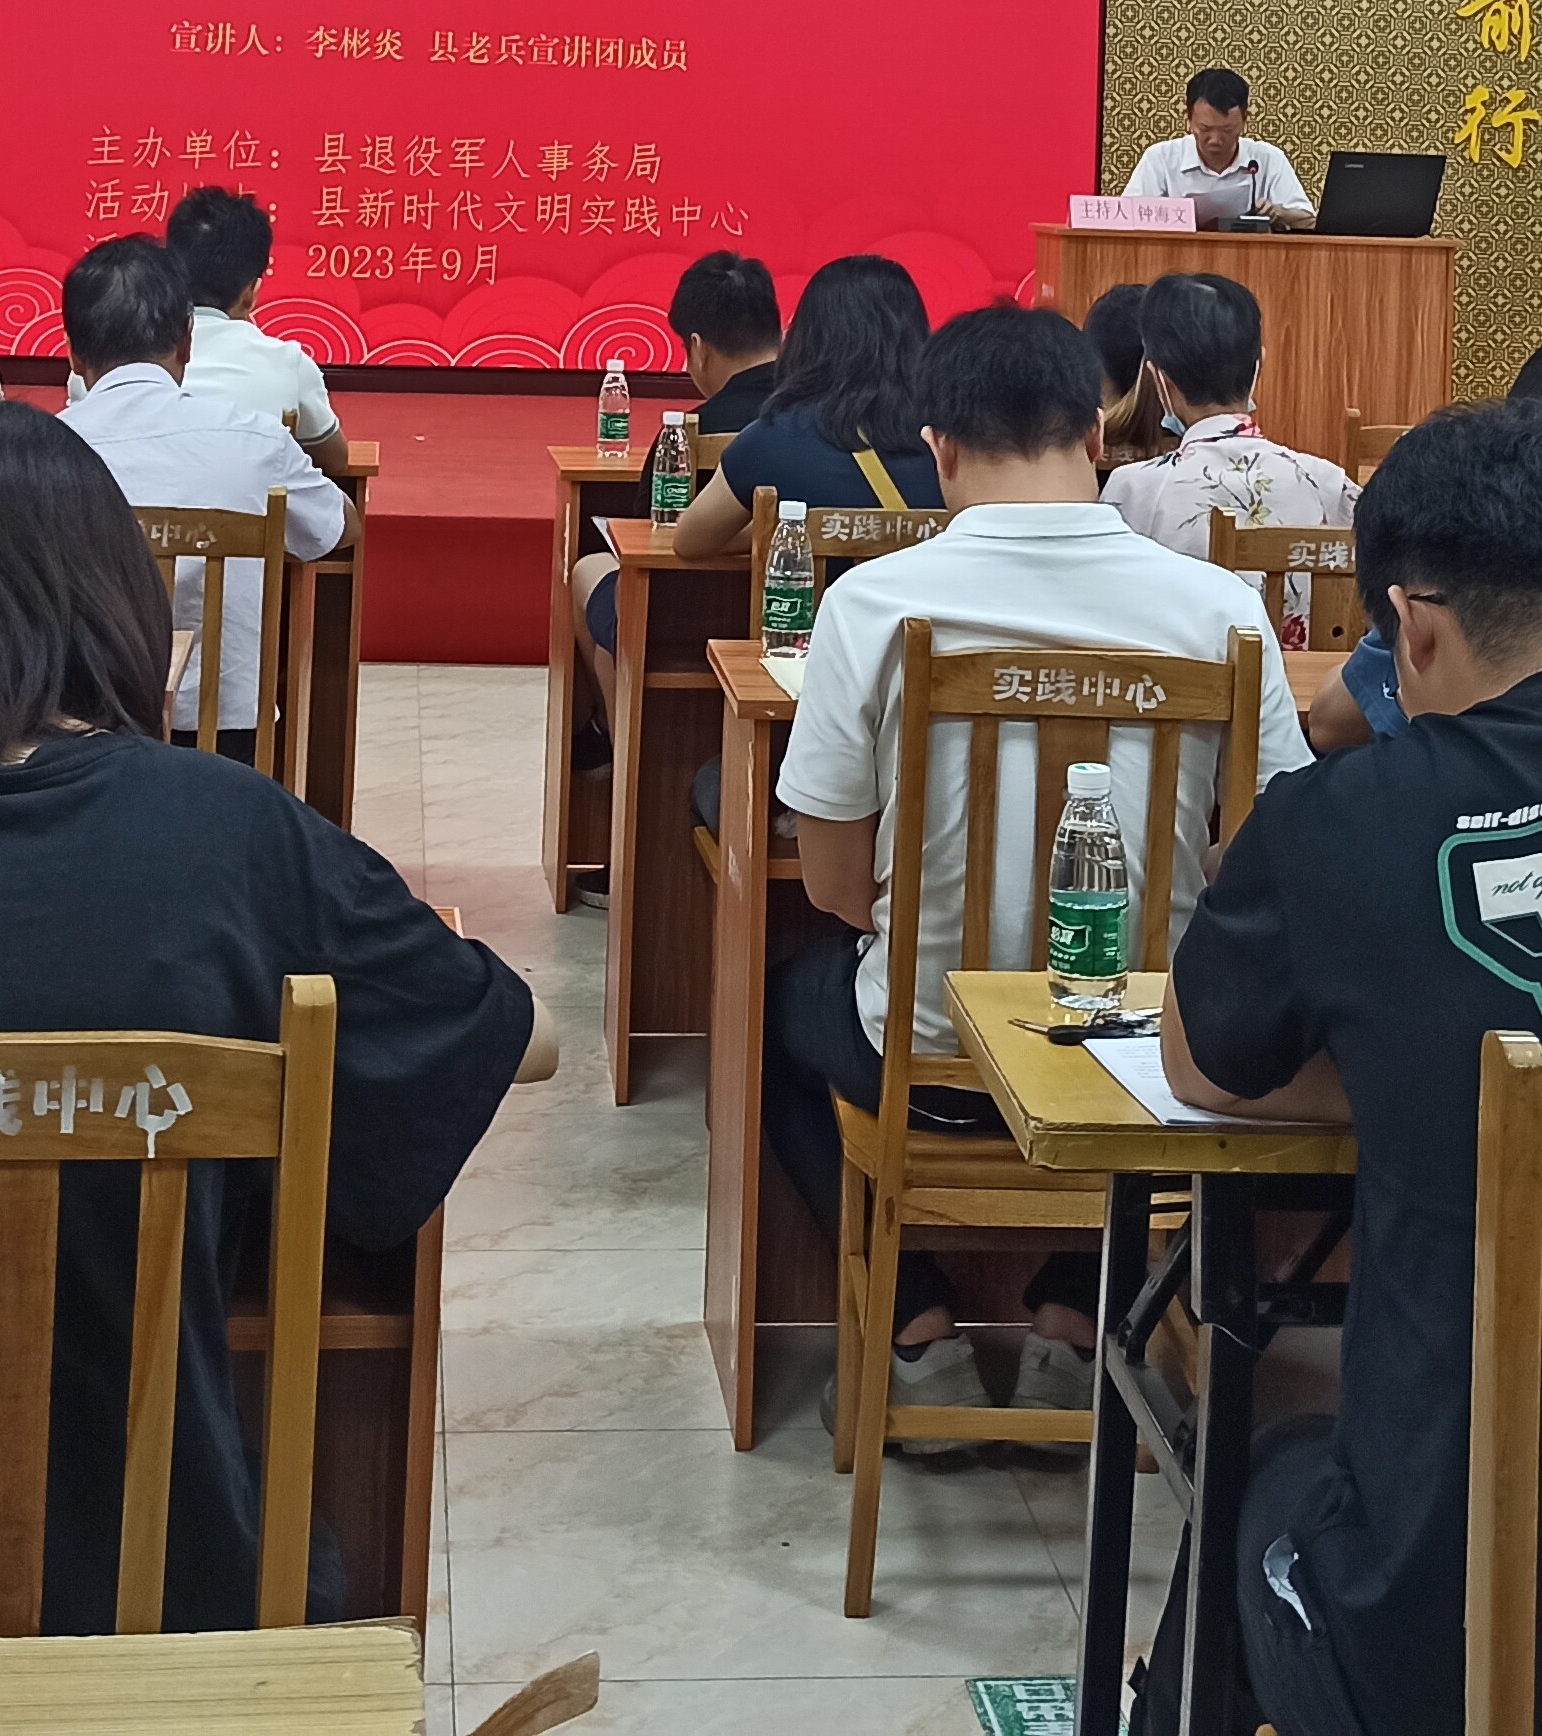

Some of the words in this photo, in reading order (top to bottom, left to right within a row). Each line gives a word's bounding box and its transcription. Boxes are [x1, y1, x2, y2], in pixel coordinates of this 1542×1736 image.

[427, 30, 690, 72] 县老兵宣讲团成员
[1287, 539, 1355, 571] 实践
[992, 665, 1167, 714] 实践中心
[1492, 873, 1529, 896] not
